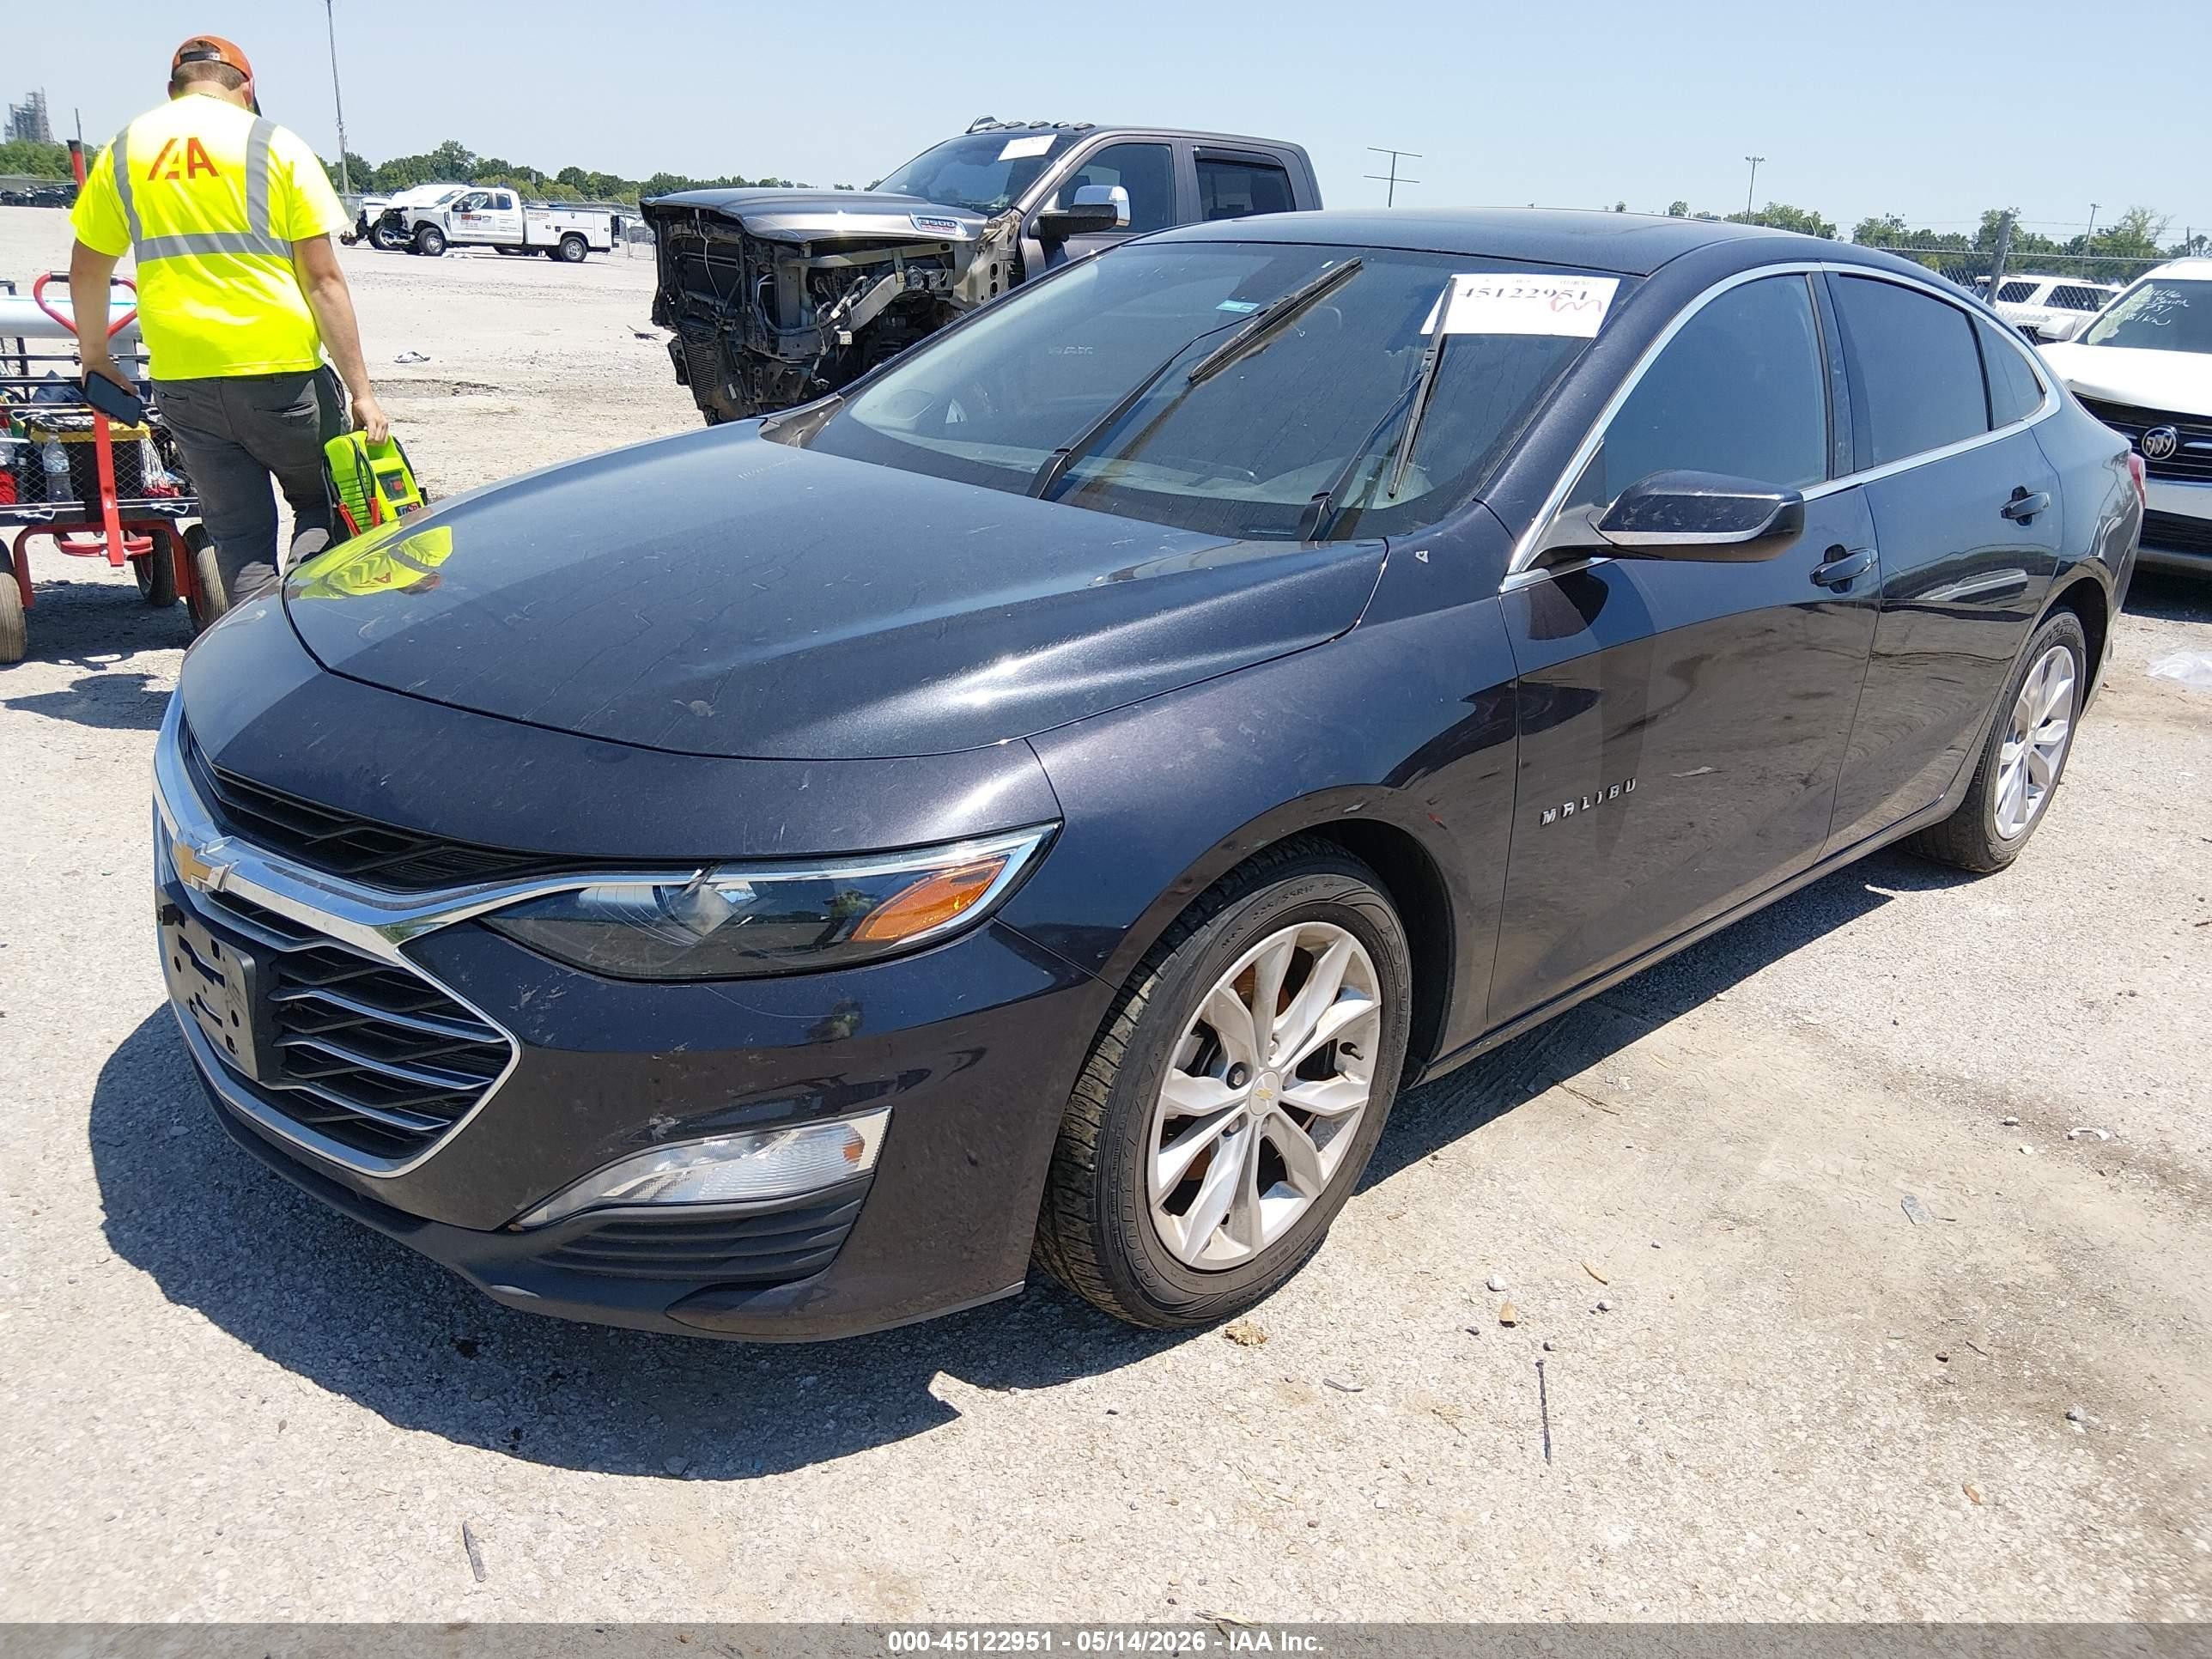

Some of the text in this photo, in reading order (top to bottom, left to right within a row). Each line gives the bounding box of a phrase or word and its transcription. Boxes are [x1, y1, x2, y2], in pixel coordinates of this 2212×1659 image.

[920, 219, 956, 228] 3500
[1459, 288, 1588, 301] 45122951
[1540, 777, 1637, 826] MALIBU
